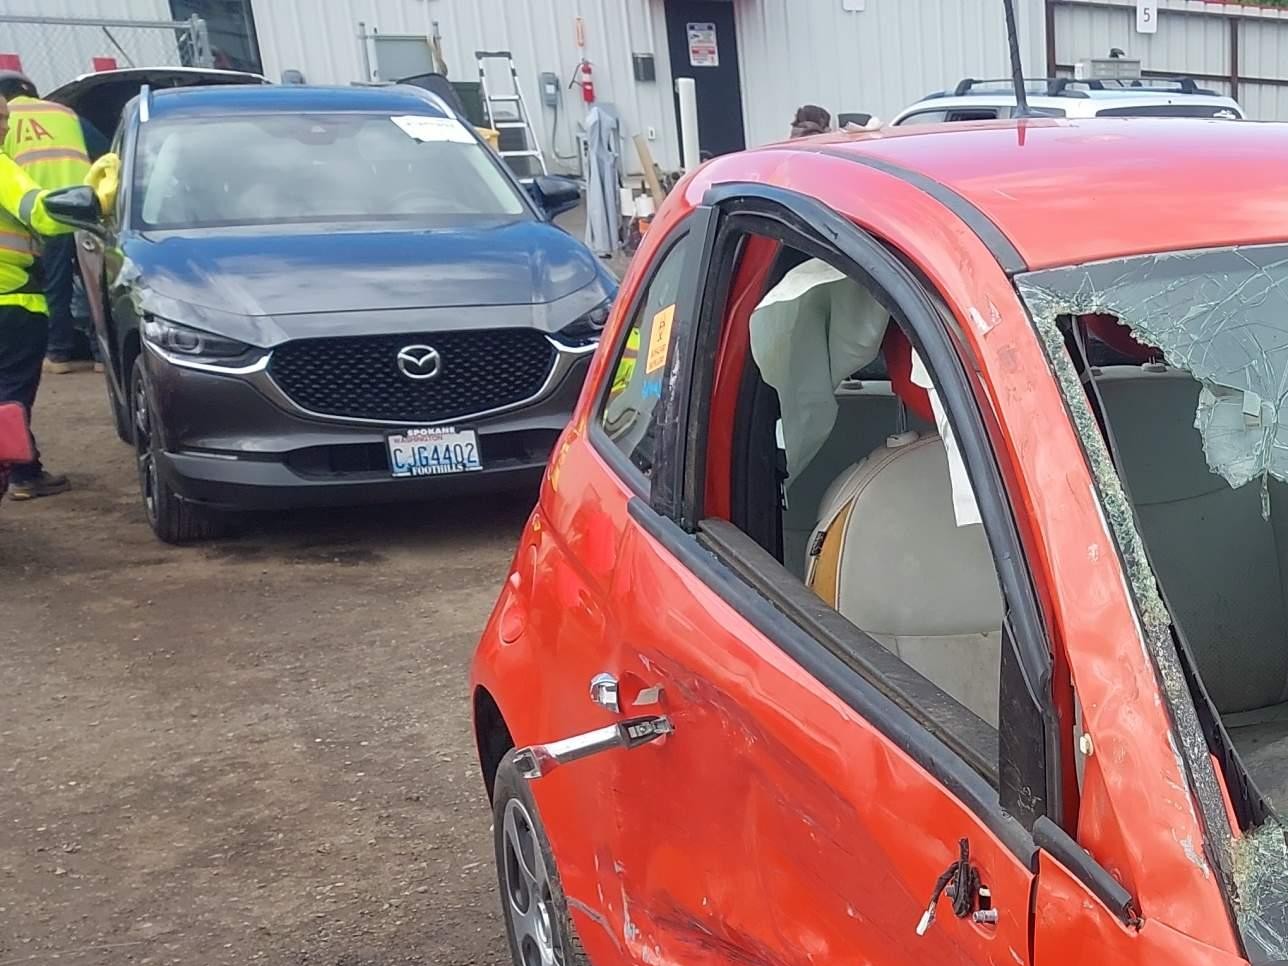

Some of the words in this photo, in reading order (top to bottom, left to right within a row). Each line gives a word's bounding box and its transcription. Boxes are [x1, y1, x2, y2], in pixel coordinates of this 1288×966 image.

[1143, 7, 1151, 23] 5
[406, 426, 456, 438] SPOKANE
[393, 443, 478, 470] CJG4402
[411, 463, 464, 476] FOOTHILLS
